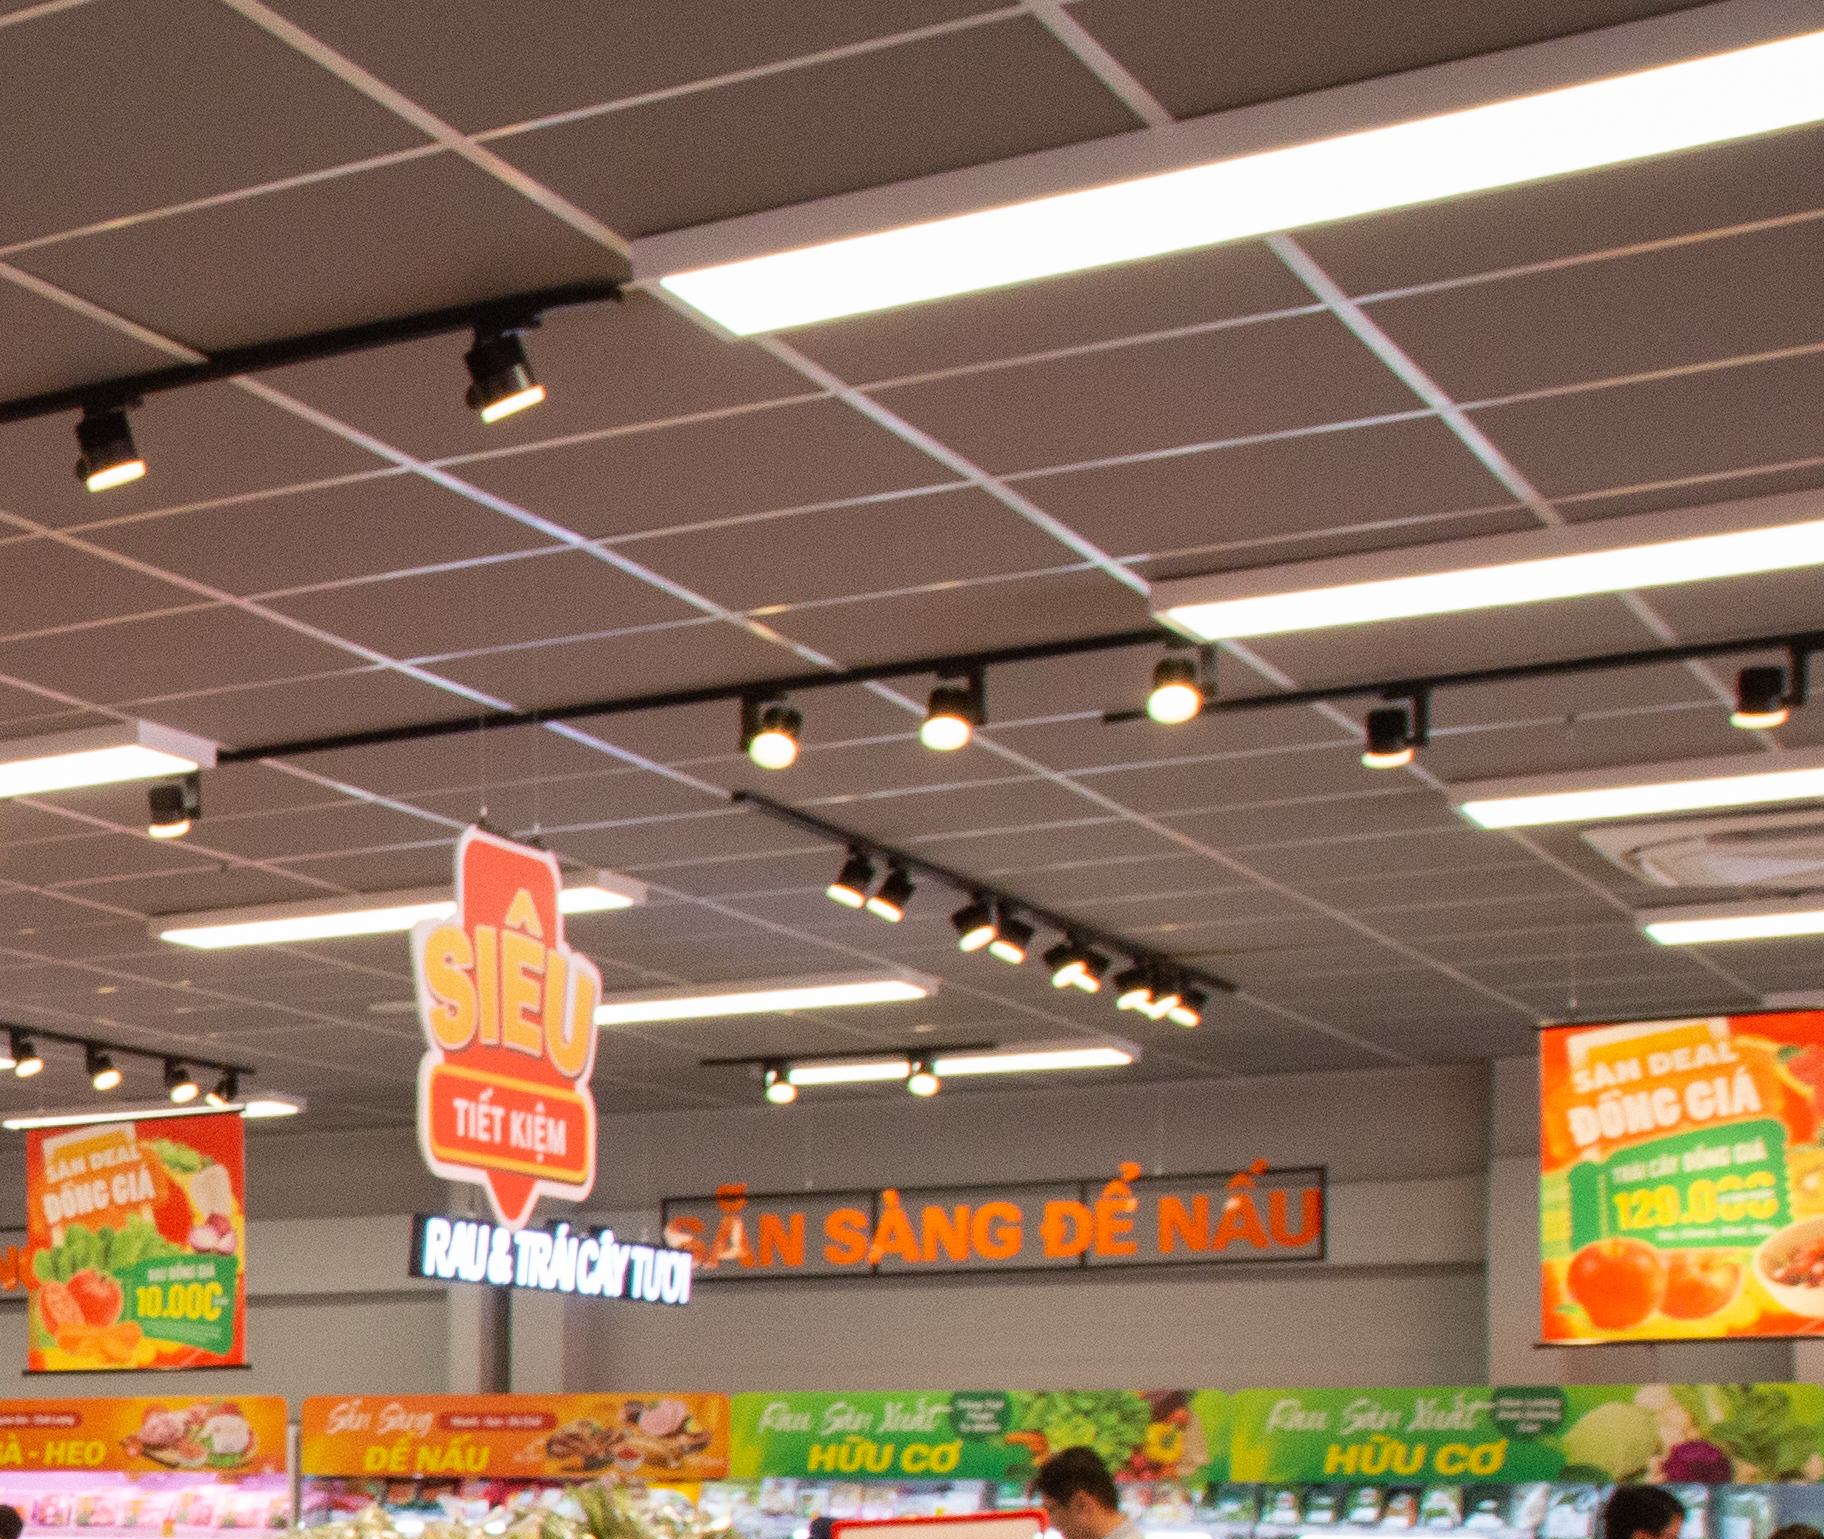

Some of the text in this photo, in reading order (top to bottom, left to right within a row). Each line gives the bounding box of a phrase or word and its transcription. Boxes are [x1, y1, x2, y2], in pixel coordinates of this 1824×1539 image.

[422, 888, 597, 1078] SIÊU
[1648, 1042, 1739, 1076] DEAL
[1685, 1065, 1762, 1120] GIÁ
[452, 1087, 567, 1163] TIẾT KIỆM
[112, 1162, 157, 1206] GIÁ
[664, 1158, 1322, 1269] SẴN SÀNG ĐỂ NẤU
[422, 1217, 631, 1297] RAU & TRÁI CÂY
[43, 1440, 107, 1466] HEO
[808, 1435, 963, 1472] HỮU CƠ
[1325, 1434, 1509, 1474] HỮU CƠ
